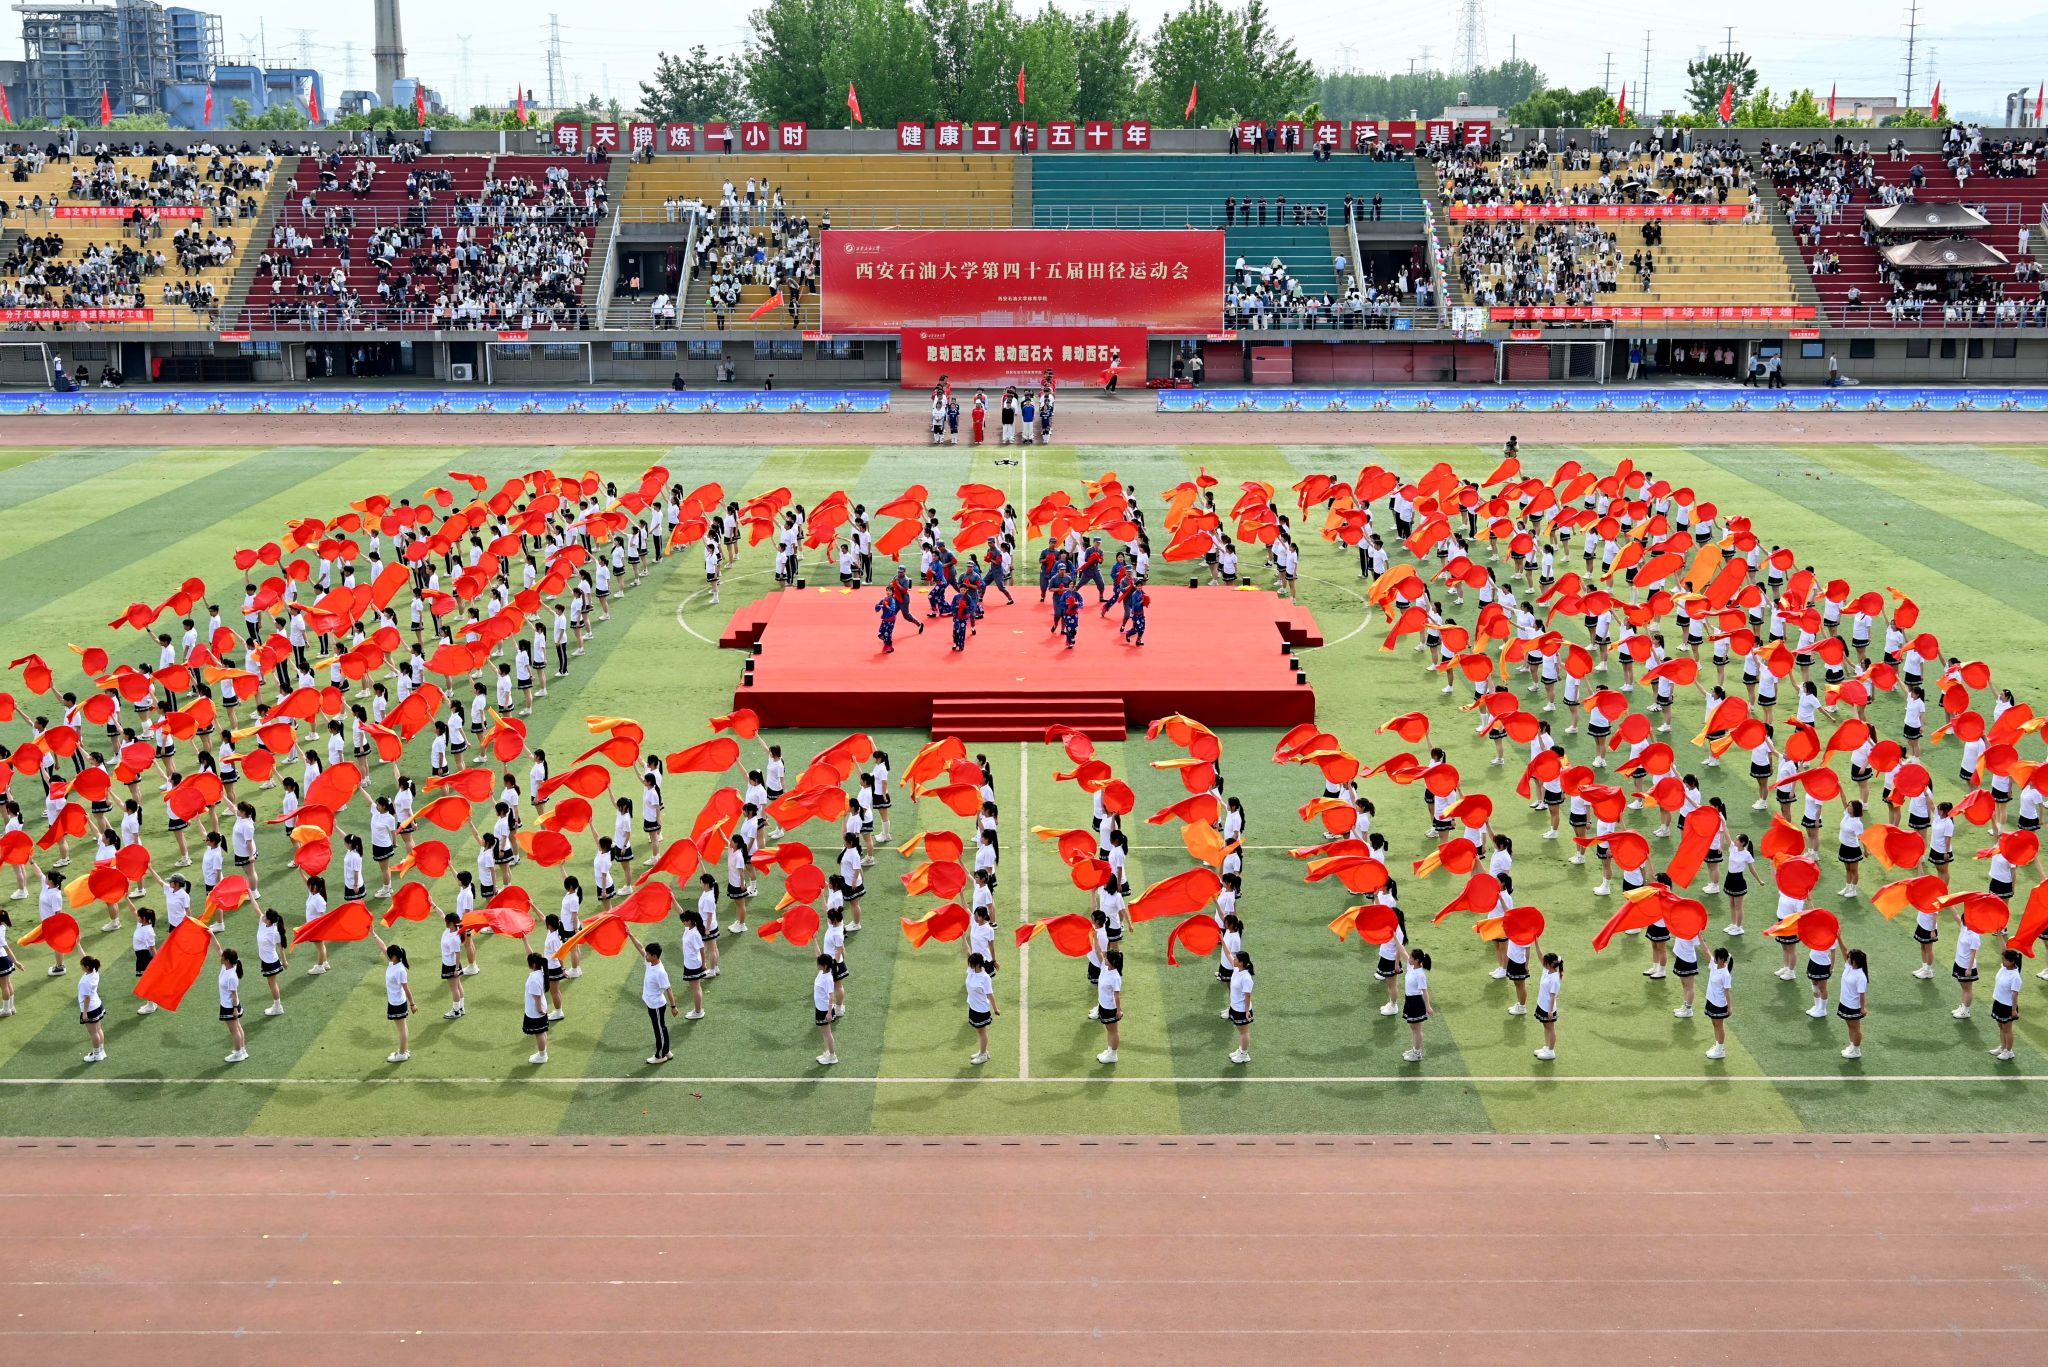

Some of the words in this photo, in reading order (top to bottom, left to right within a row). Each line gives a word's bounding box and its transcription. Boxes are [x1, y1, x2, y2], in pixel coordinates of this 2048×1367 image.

[558, 126, 803, 147] 每天锻炼一小时
[901, 125, 1147, 146] 健康工作五十年
[856, 261, 1189, 280] 西安石油大学第四十五届田径运动会
[1513, 307, 1643, 318] 经管健儿展风采
[927, 345, 986, 362] 跑动西石大
[994, 345, 1053, 362] 跳动西石大
[1062, 345, 1120, 362] 舞动西石大
